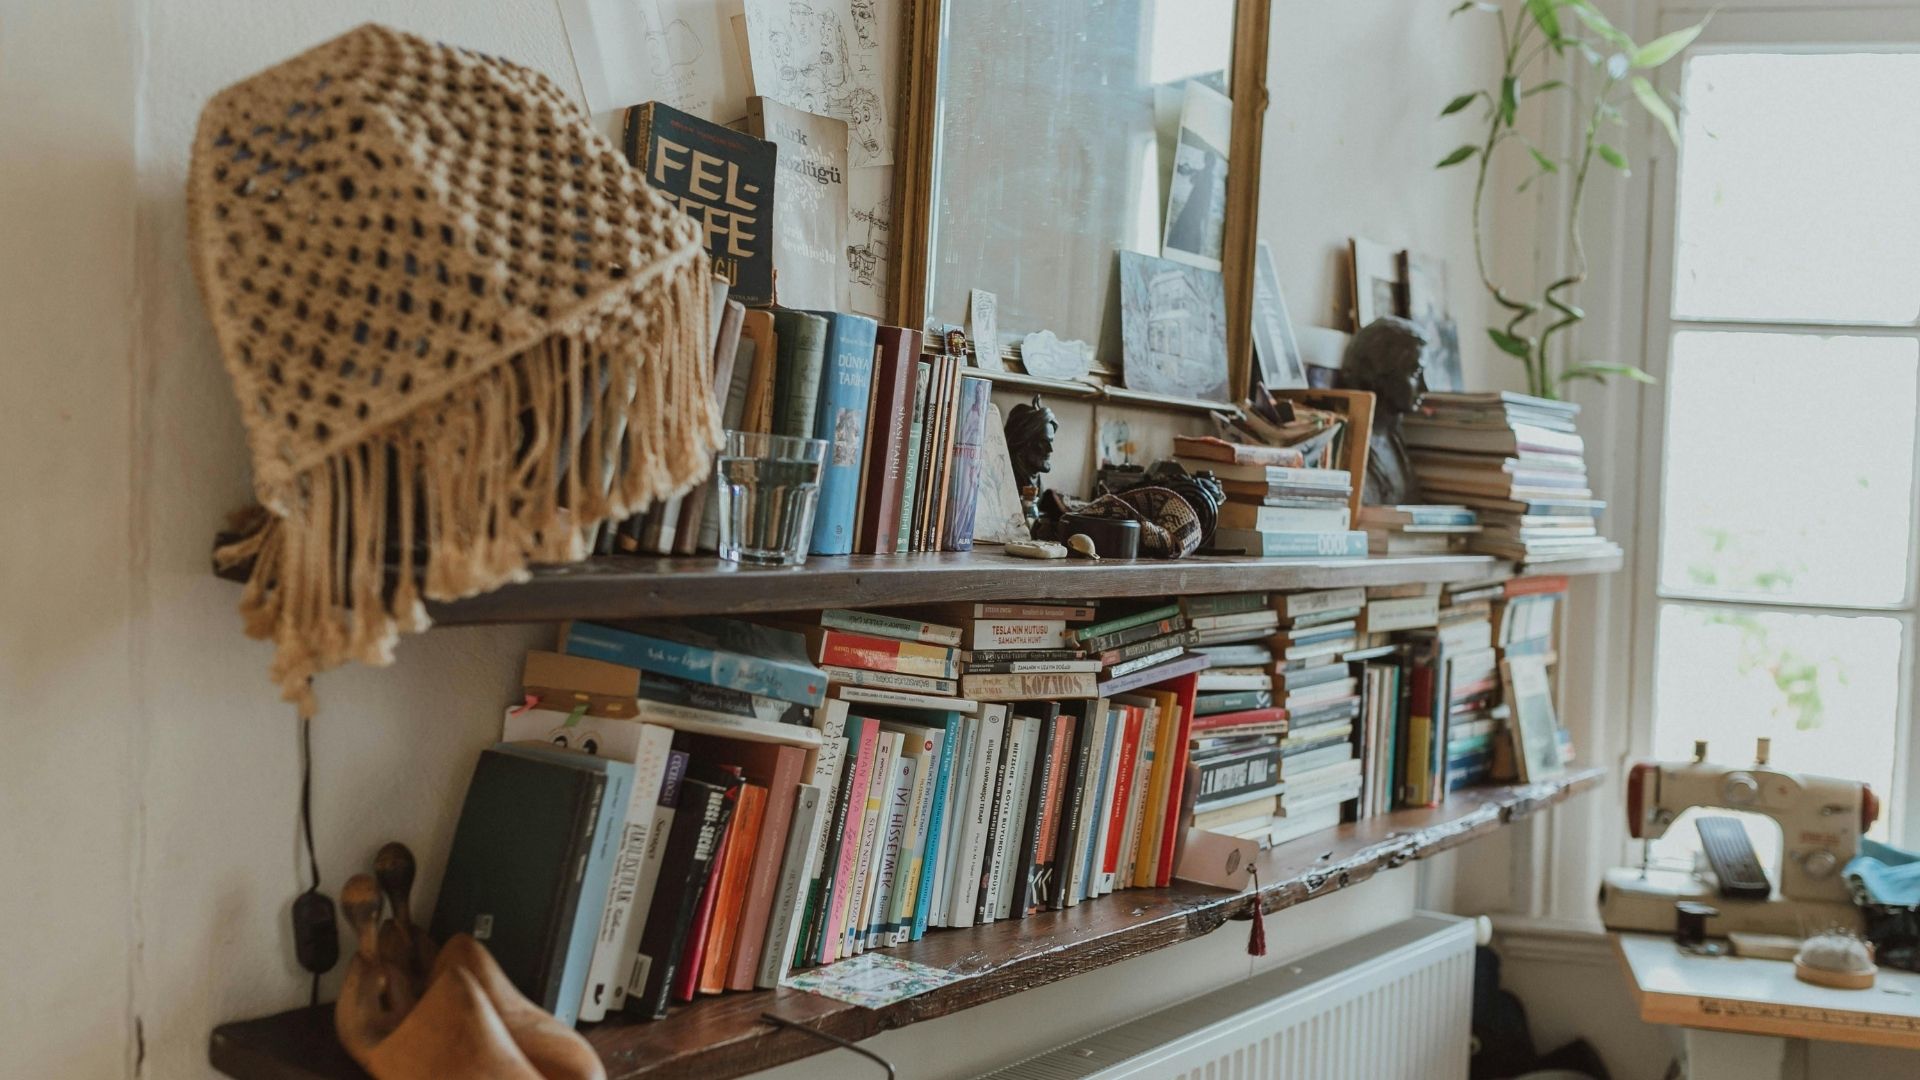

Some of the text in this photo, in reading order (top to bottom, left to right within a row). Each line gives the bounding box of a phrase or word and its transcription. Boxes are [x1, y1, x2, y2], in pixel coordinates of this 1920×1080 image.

[775, 121, 808, 146] türk
[654, 135, 760, 211] FEL-
[838, 353, 870, 370] DÜNYA
[1024, 625, 1048, 634] KUTUSU
[1027, 636, 1041, 644] HUNT
[1021, 675, 1083, 696] KOZMOS
[815, 721, 833, 773] CILAR
[824, 722, 845, 775] YARATI
[894, 784, 910, 809] İYİ
[1003, 789, 1011, 814] BÖYLE
[1074, 786, 1082, 804] Patti
[1071, 806, 1079, 830] Smith
[996, 817, 1006, 857] BUYURDU
[878, 814, 903, 887] HİSSETMEK
